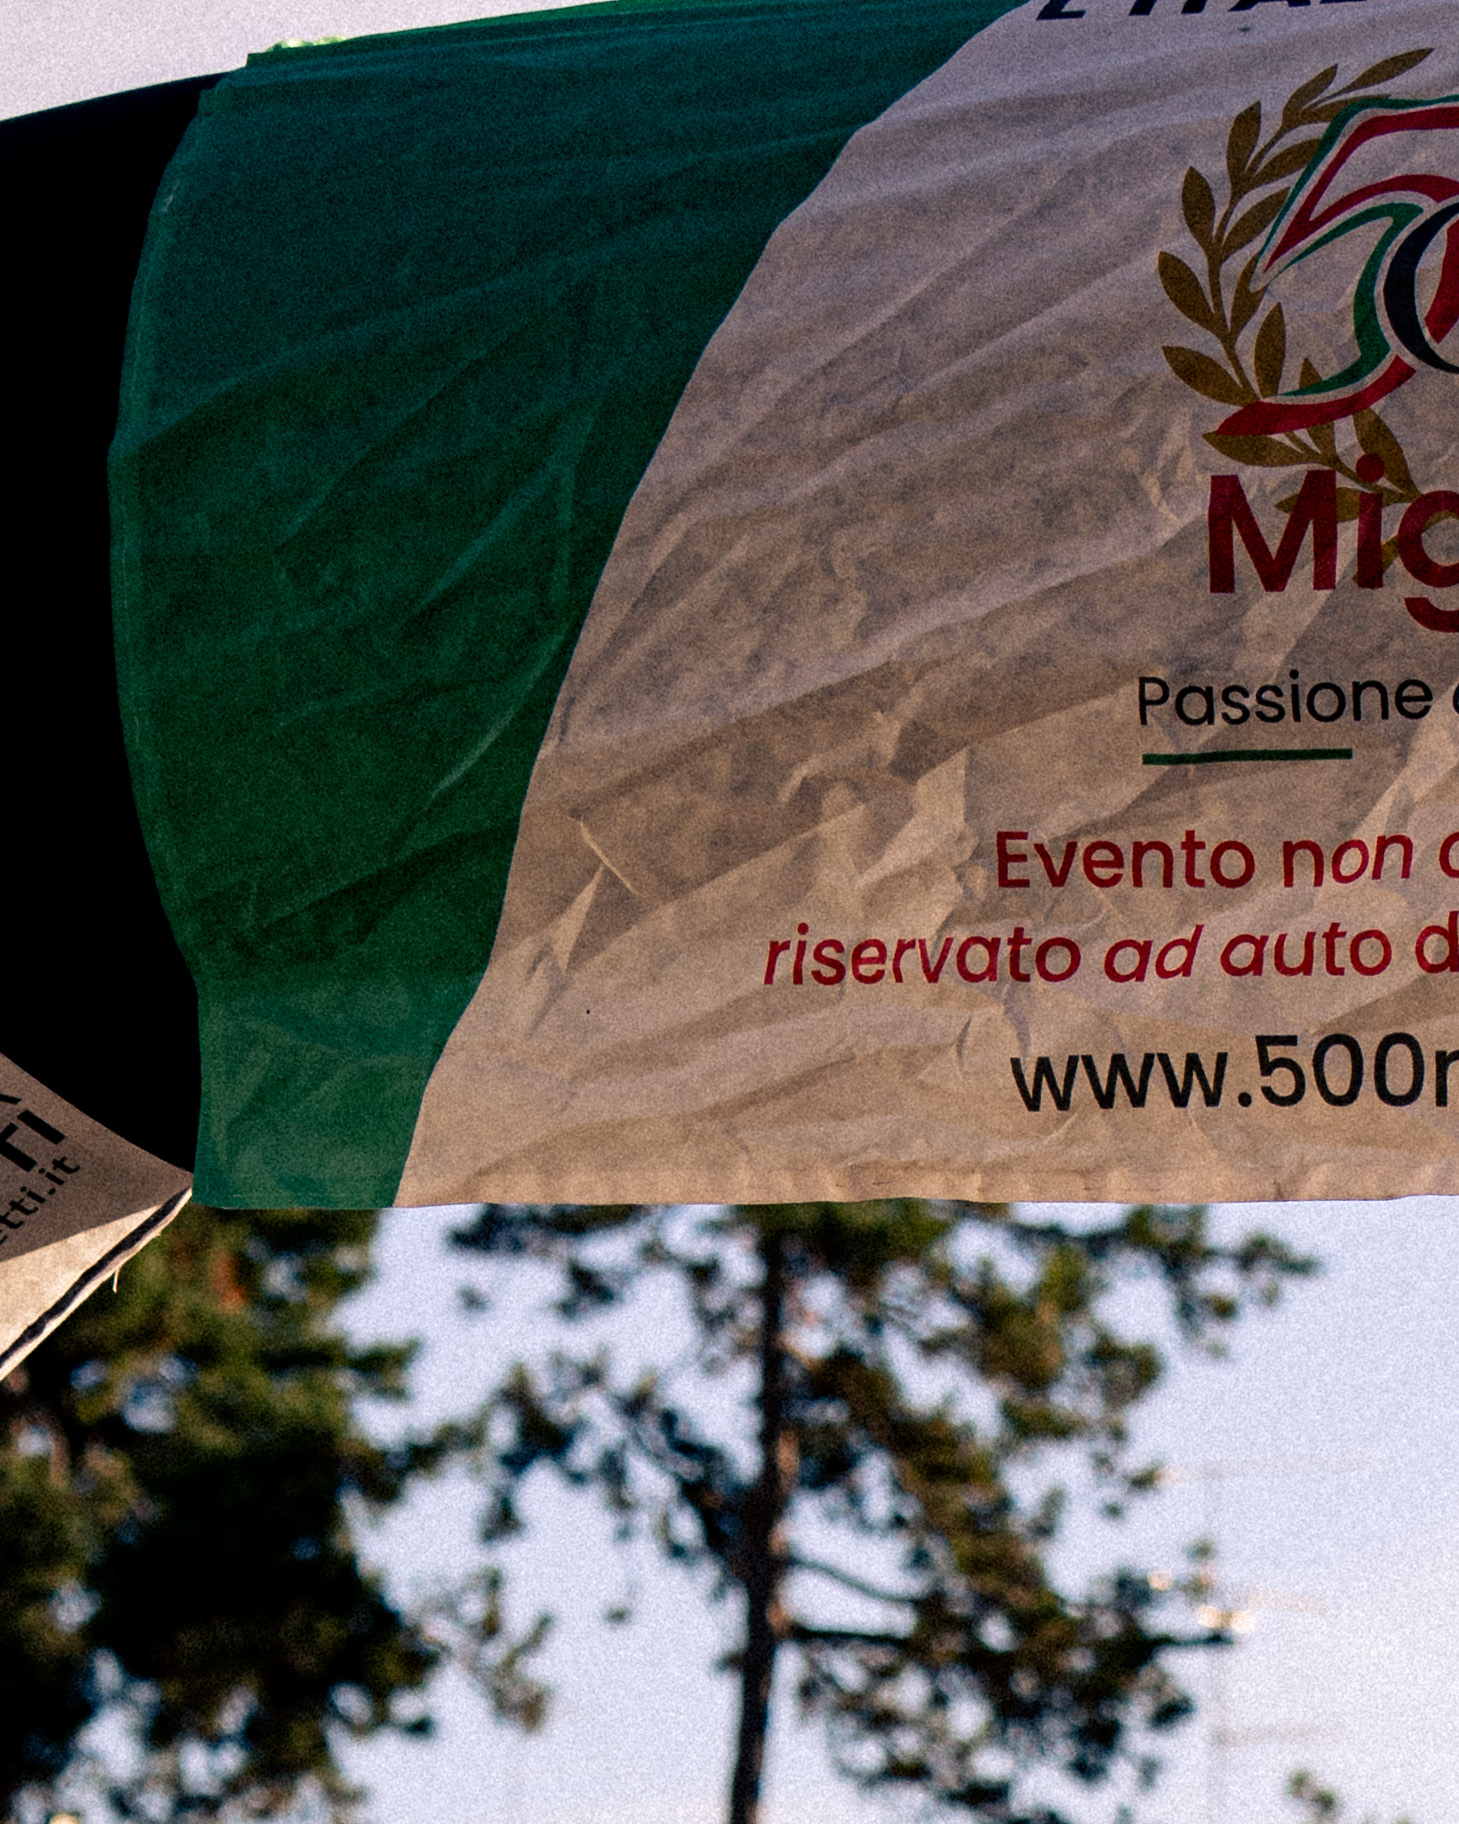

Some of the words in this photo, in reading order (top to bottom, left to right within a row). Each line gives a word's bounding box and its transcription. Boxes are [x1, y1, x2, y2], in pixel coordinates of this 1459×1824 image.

[1138, 669, 1434, 727] Passione
[996, 829, 1256, 890] Evento
[1282, 832, 1414, 889] non
[763, 922, 1083, 986] riservato
[1103, 924, 1204, 983] ad
[1220, 921, 1393, 979] auto
